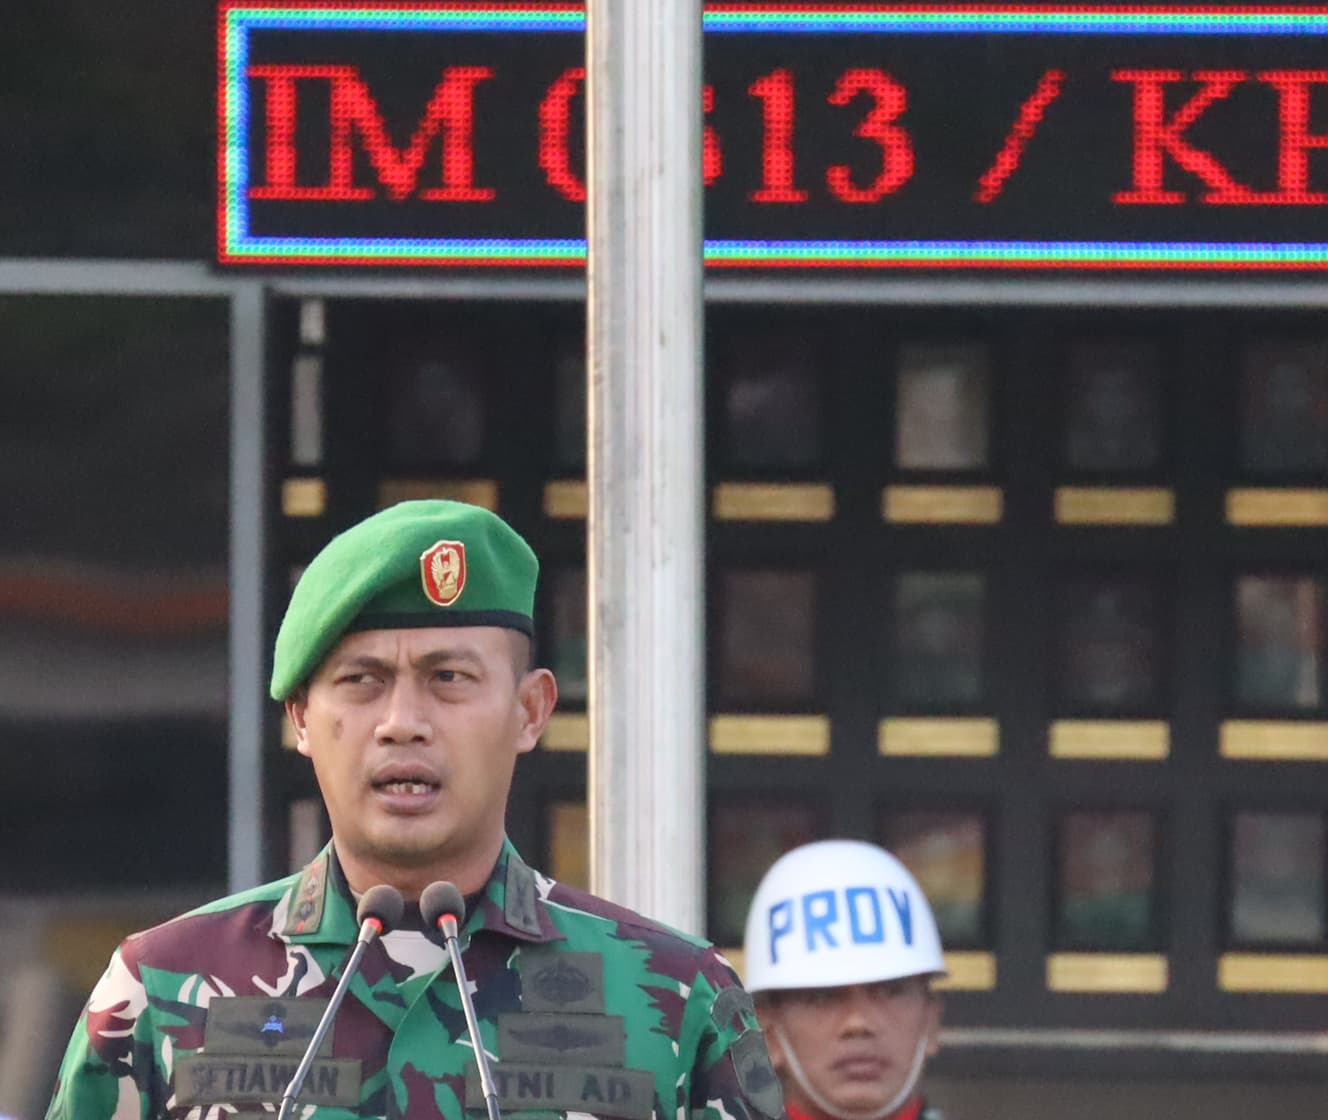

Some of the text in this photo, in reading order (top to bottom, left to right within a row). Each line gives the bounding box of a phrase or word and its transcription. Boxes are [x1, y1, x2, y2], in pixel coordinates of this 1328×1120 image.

[537, 65, 913, 203] 013
[974, 68, 1065, 202] /
[768, 886, 913, 965] PROV
[493, 1070, 633, 1103] TNI AD
